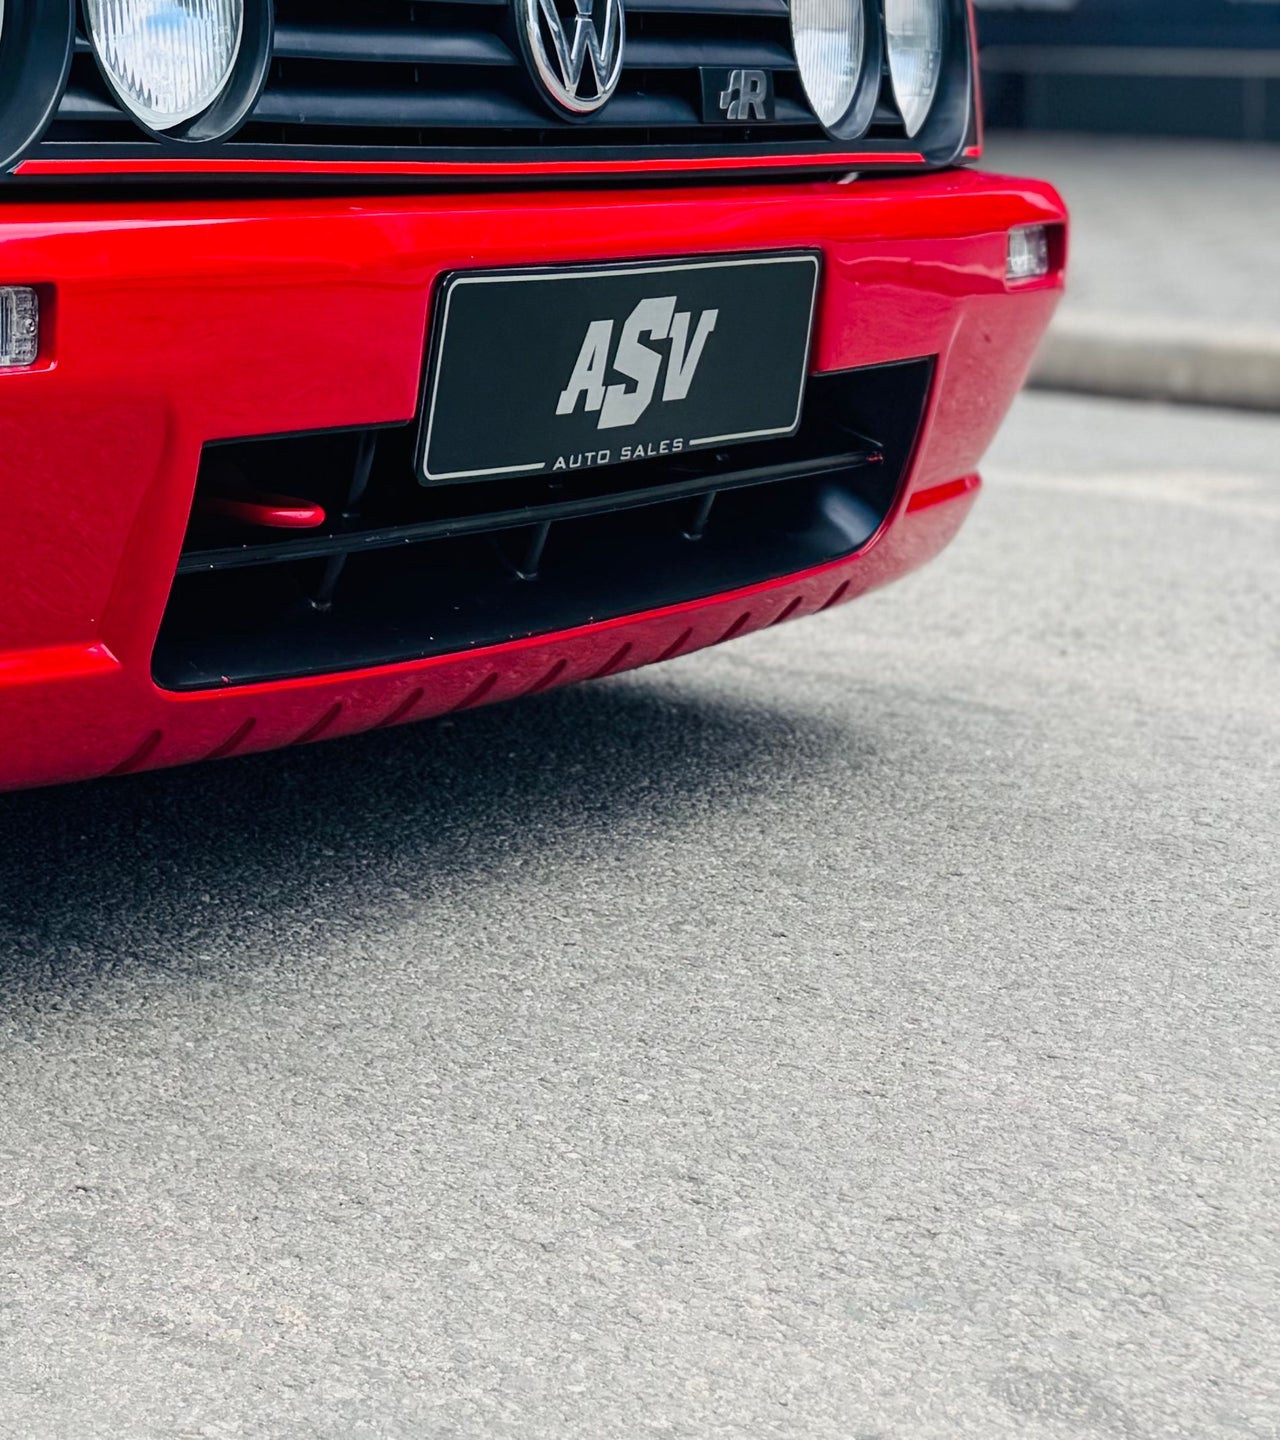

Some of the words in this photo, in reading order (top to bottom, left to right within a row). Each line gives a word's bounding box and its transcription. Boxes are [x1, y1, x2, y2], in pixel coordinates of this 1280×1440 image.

[554, 295, 719, 430] ASV
[552, 448, 611, 471] AUTO
[620, 438, 684, 460] SALES
